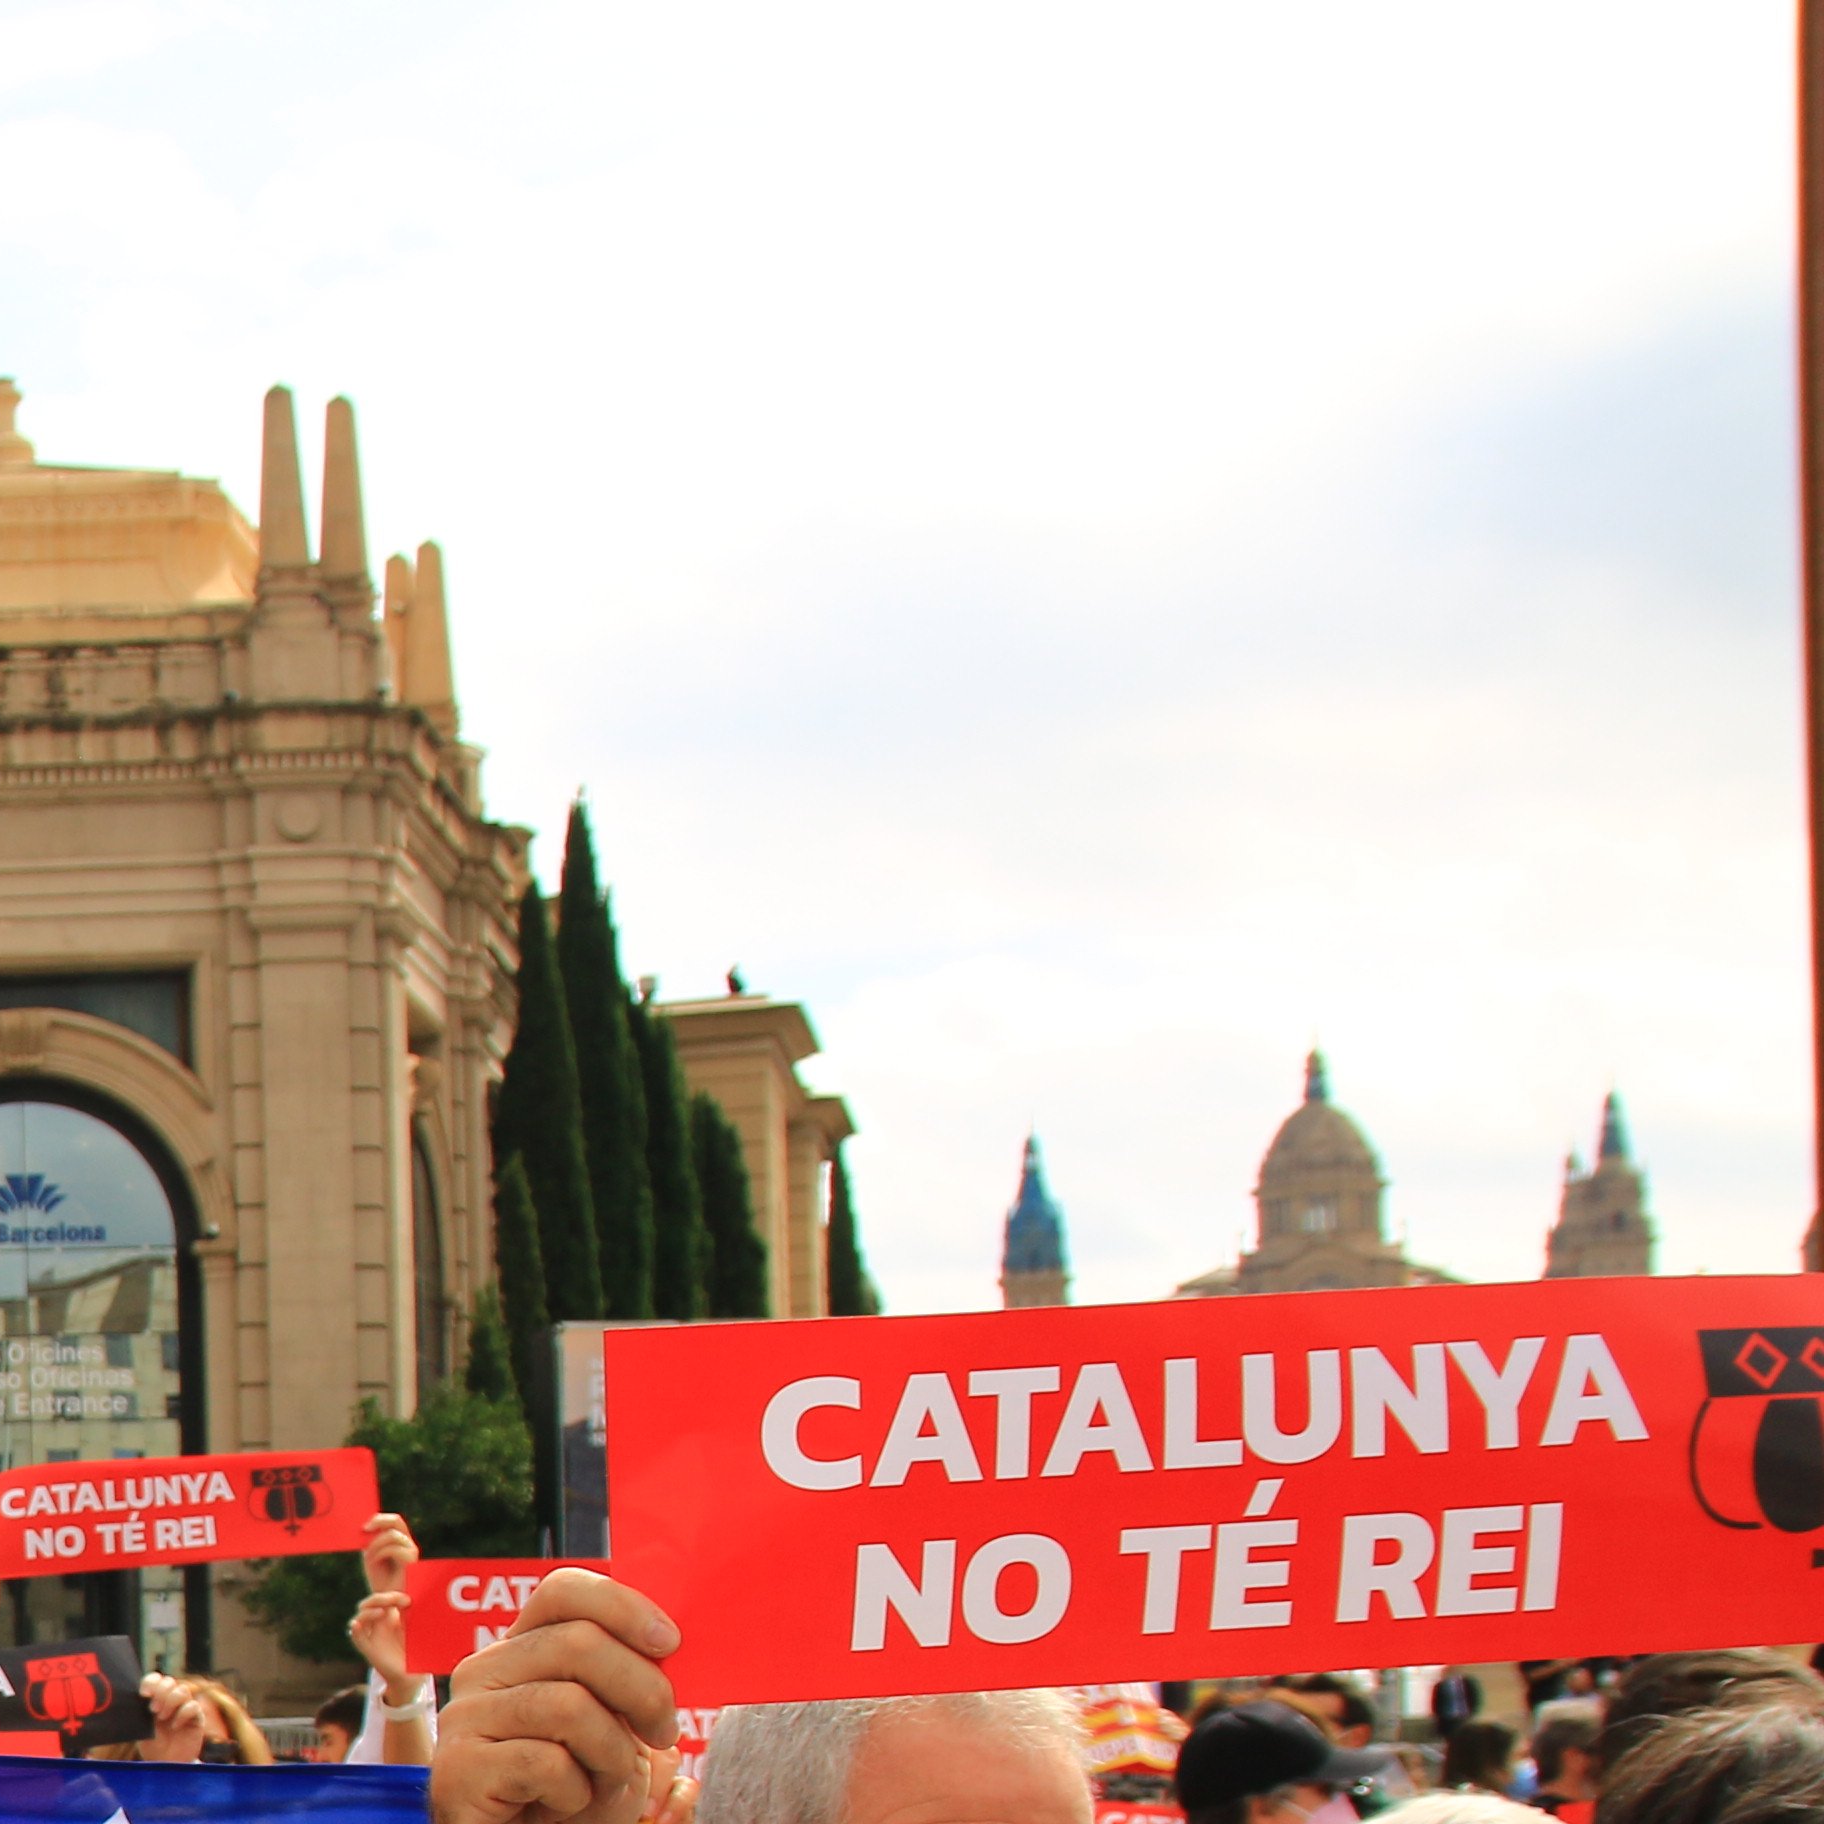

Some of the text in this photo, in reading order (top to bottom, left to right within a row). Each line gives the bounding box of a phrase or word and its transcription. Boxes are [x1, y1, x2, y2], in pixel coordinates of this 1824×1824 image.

[13, 1392, 129, 1416] Entrance
[761, 1334, 1649, 1491] CATALUNYA
[0, 1470, 234, 1520] CATALUNYA
[25, 1511, 218, 1561] NO TÉ REI
[851, 1479, 1564, 1652] NO TÉ REI
